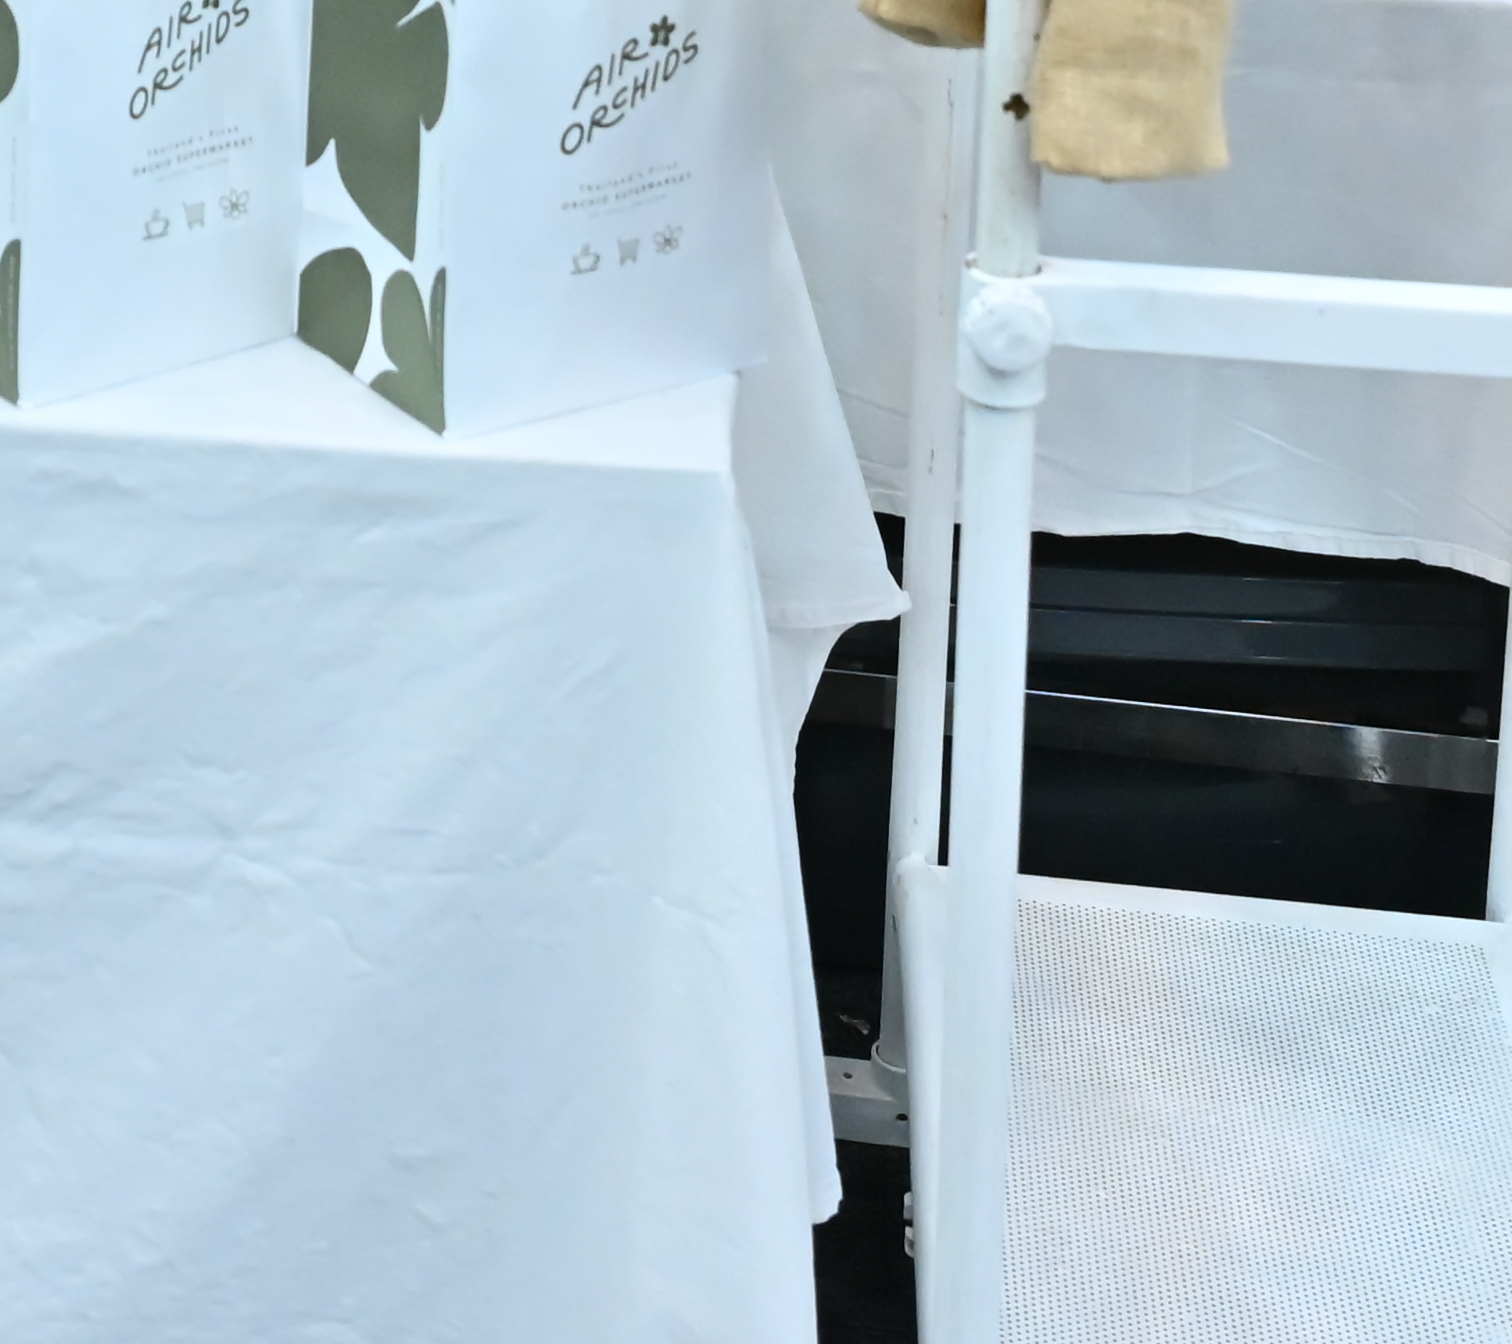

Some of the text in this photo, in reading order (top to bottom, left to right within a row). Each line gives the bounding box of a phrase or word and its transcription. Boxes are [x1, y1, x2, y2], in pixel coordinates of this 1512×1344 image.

[137, 0, 203, 75] AIR
[571, 37, 649, 111] AIR
[560, 29, 699, 155] ORCHIDS
